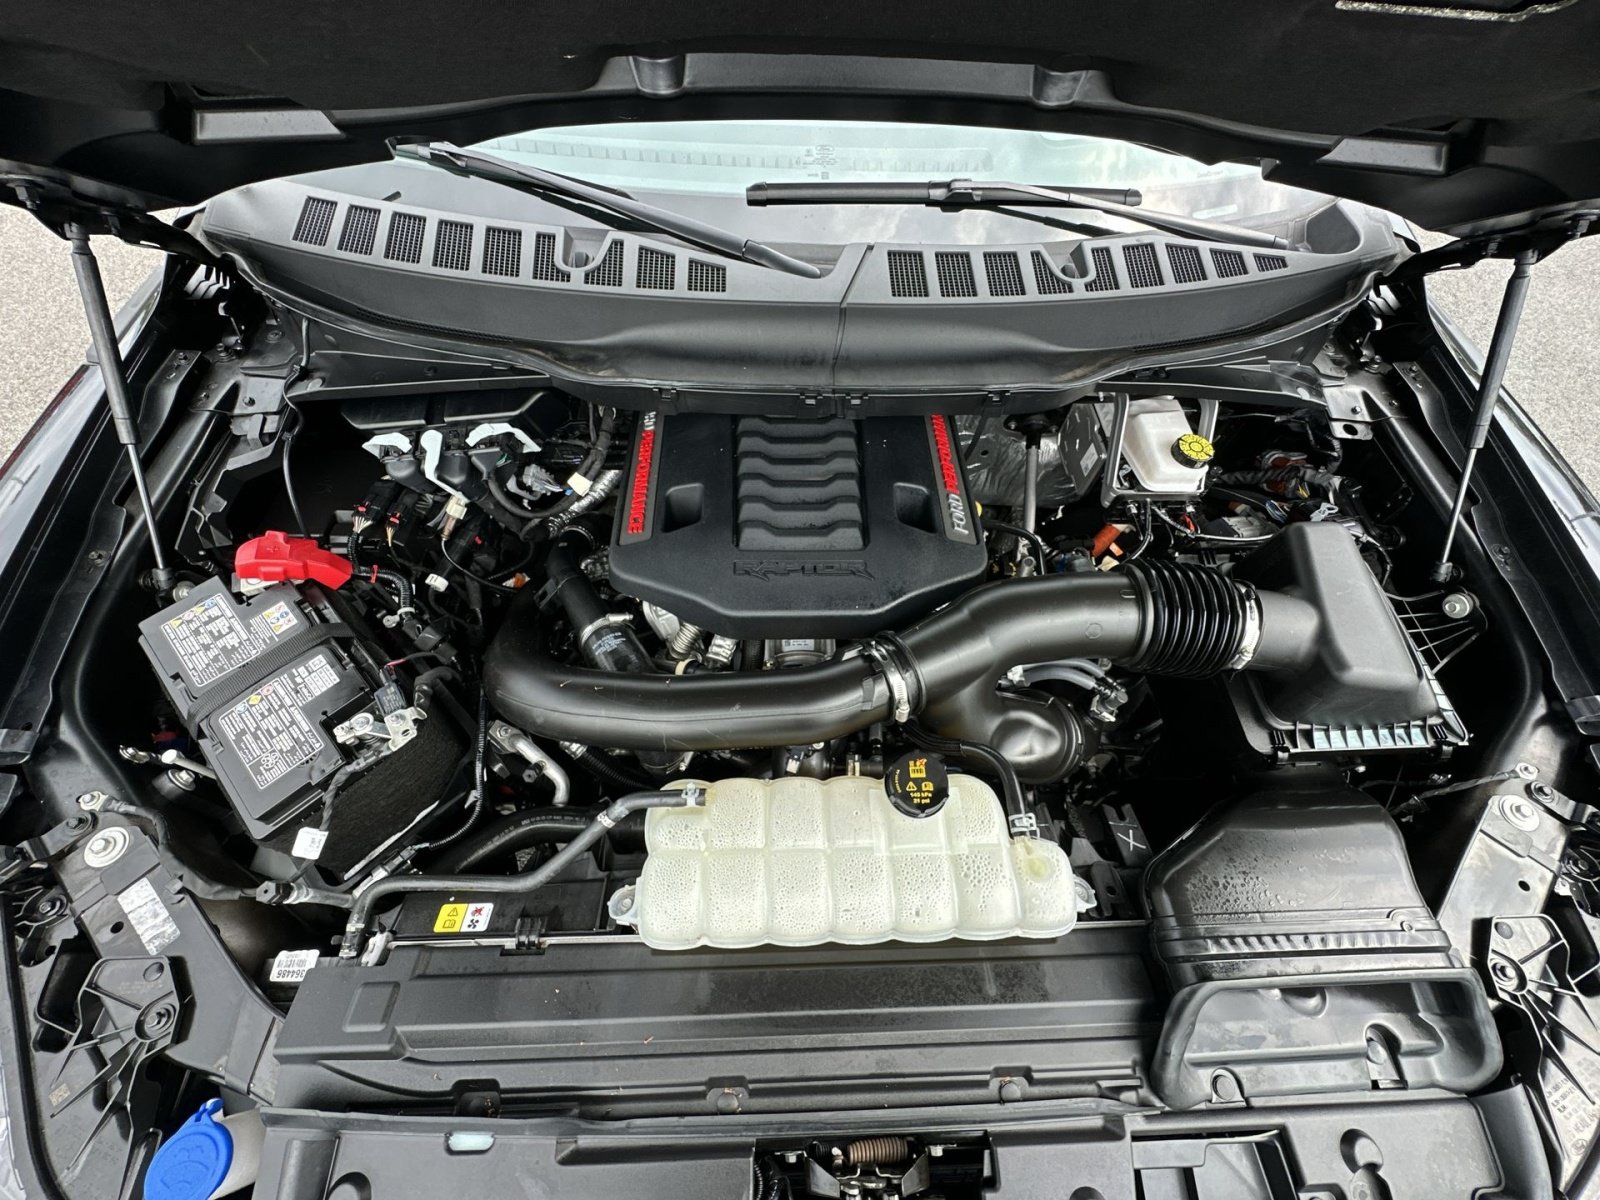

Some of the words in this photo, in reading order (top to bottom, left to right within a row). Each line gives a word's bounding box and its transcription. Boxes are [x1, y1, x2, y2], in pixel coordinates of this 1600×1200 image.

[628, 430, 656, 534] PERFORMANCE
[931, 414, 960, 494] PERFORMAN
[948, 493, 969, 535] FORD
[733, 559, 876, 582] RAPTOR
